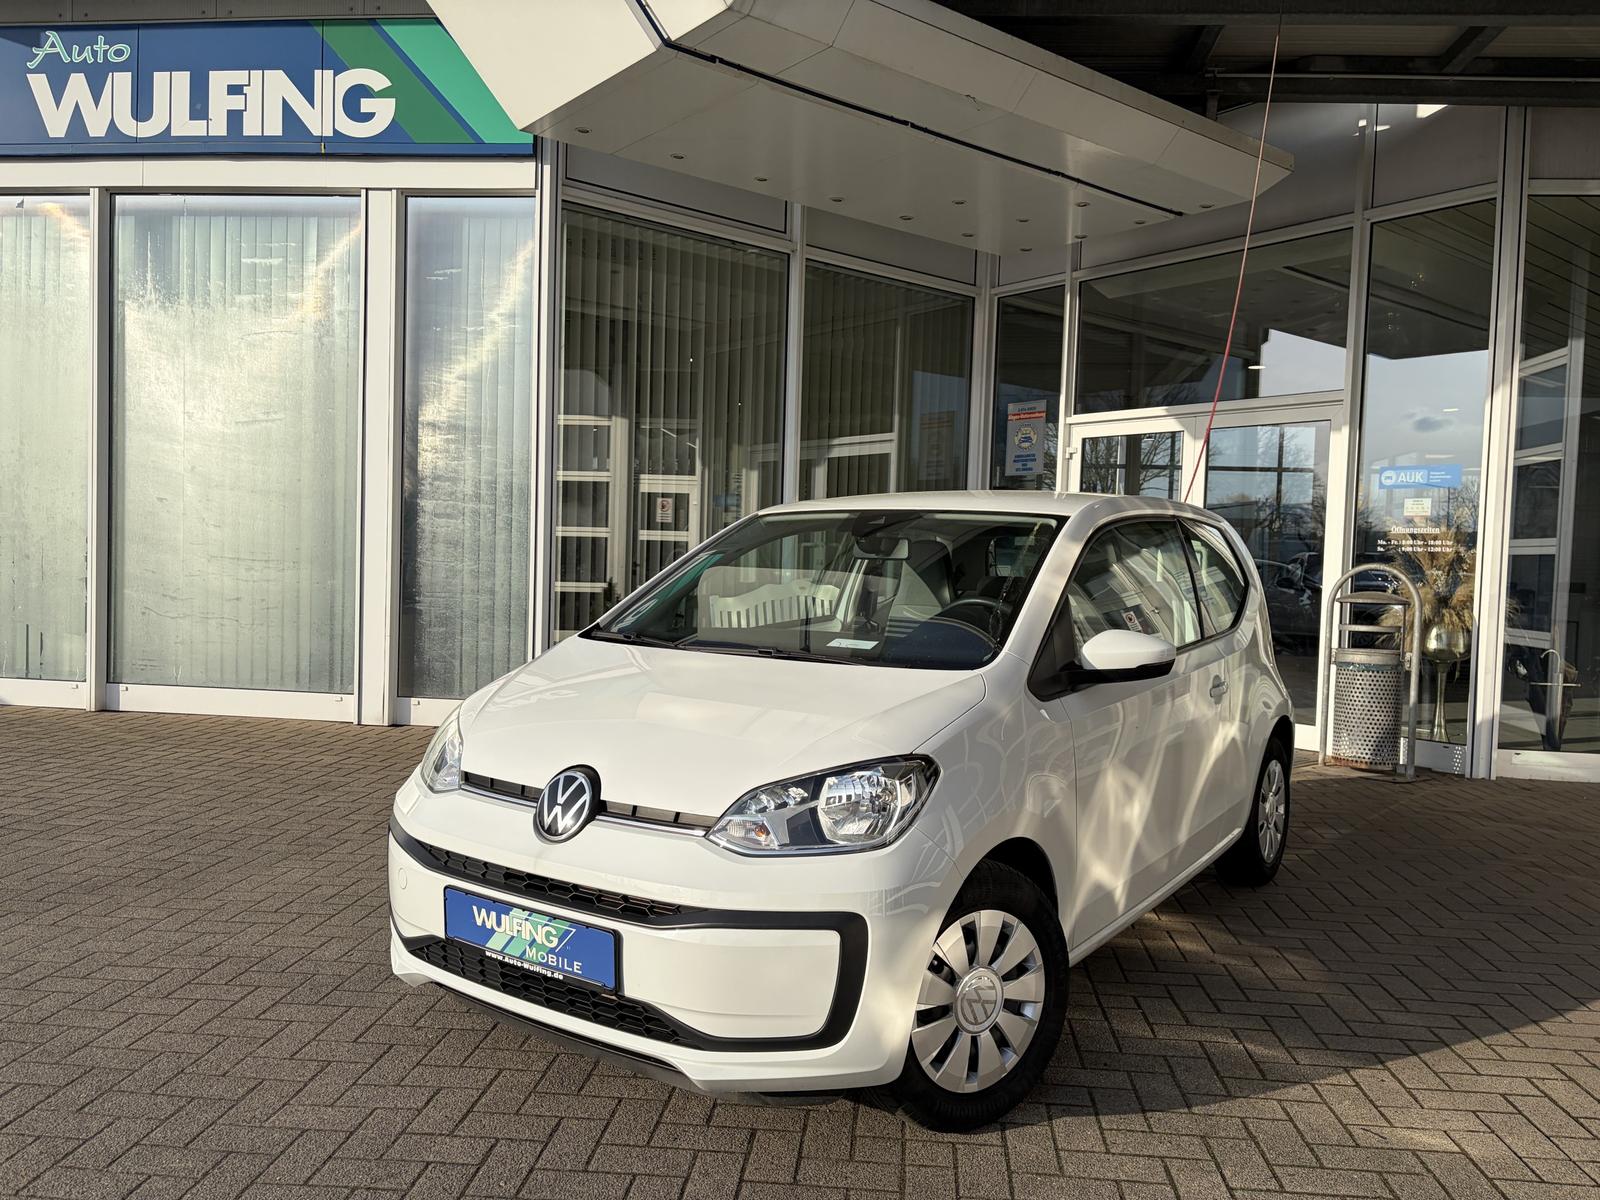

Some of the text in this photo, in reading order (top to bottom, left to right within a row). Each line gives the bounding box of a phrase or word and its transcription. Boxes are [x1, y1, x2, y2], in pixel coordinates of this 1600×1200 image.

[27, 30, 131, 69] Auto
[26, 68, 396, 138] WULFING
[1398, 471, 1424, 483] AUK
[472, 905, 559, 948] WULFING
